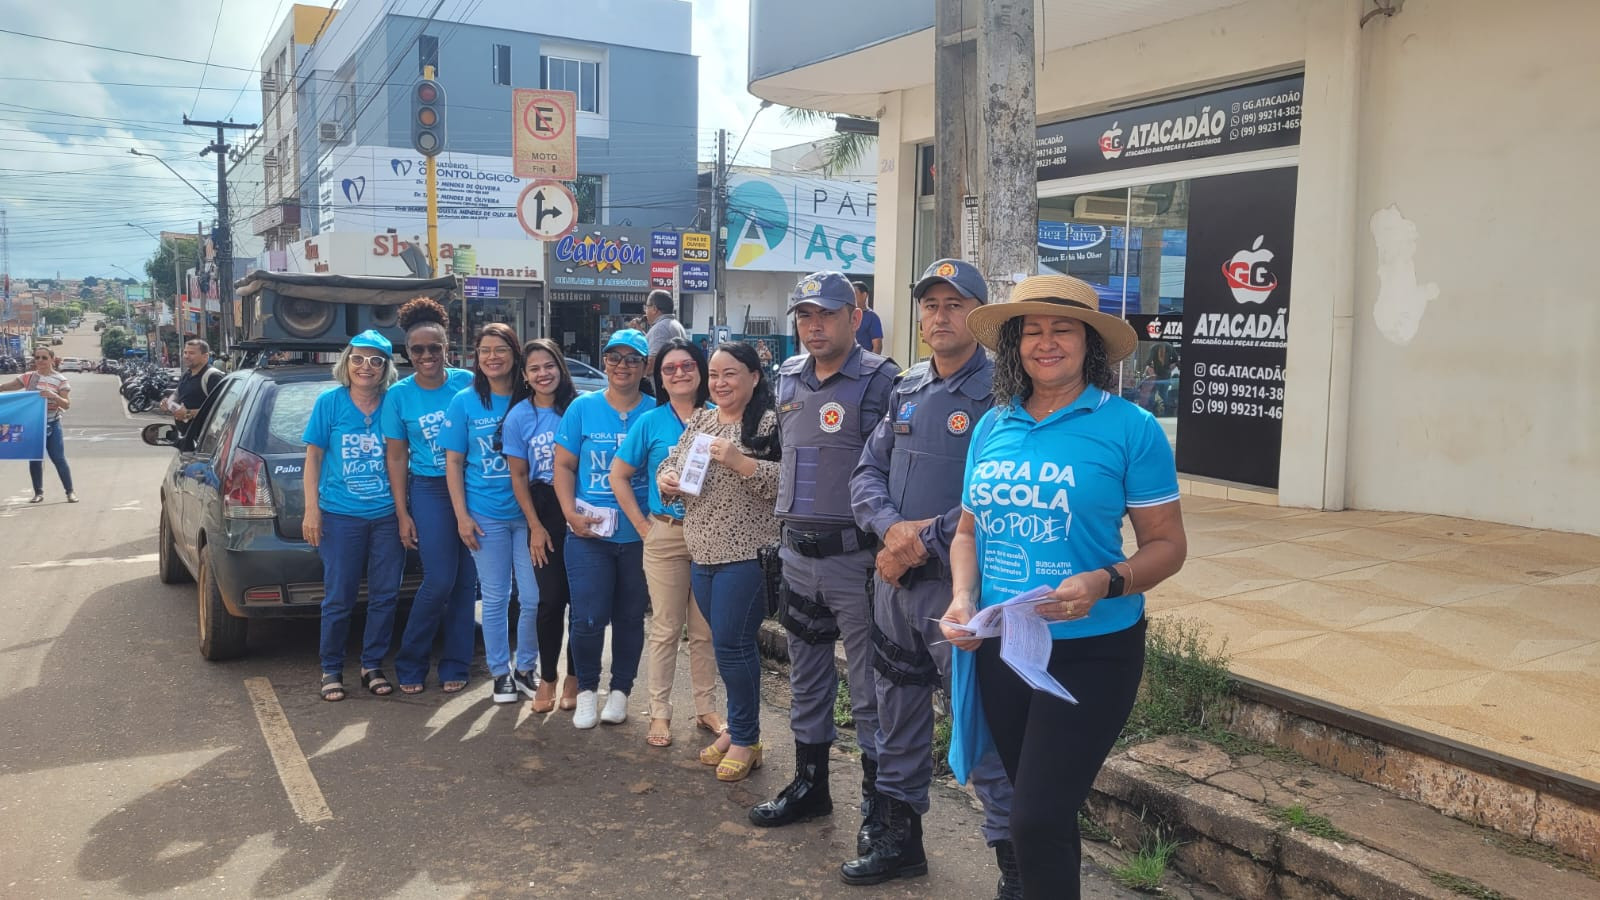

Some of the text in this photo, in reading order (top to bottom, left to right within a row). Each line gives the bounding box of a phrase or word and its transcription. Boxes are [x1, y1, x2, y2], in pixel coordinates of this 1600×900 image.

[1242, 90, 1300, 110] GG.ATACADÃO
[535, 106, 554, 132] E
[1241, 105, 1301, 125] (99) 99214-382
[1126, 106, 1226, 149] ATACADÃO
[1241, 118, 1301, 138] (99) 99231-465
[418, 160, 469, 169] COULTÓRIOS
[531, 152, 558, 161] MOTO
[555, 234, 646, 265] Cartoon
[659, 248, 677, 257] 5,99
[690, 250, 708, 259] 4,99
[690, 280, 708, 288] 9,99
[1163, 321, 1183, 335] ATA
[1193, 307, 1287, 340] ATACADÃ
[1208, 381, 1284, 400] (99) 99214-38
[1207, 399, 1283, 419] (99) 99231-46
[590, 432, 612, 440] FORA
[274, 464, 302, 474] Palio
[972, 460, 1076, 487] FORA DA
[969, 482, 1070, 513] ESCOLA
[1035, 567, 1073, 576] ESCOLAR
